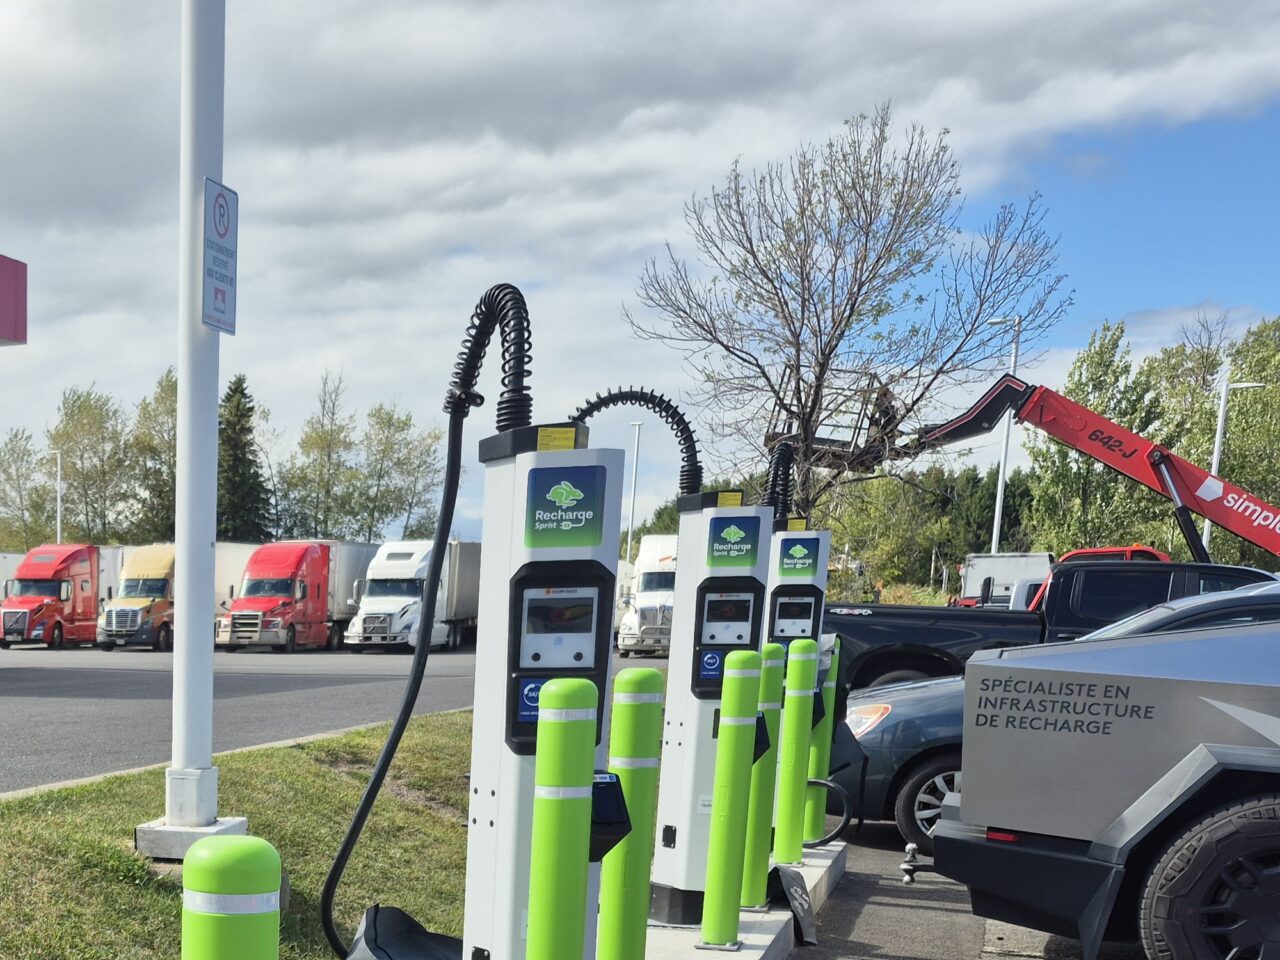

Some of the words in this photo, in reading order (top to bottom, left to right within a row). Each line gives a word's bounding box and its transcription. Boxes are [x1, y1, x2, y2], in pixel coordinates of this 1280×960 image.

[1087, 428, 1139, 459] 642-J
[534, 521, 557, 531] Sprint
[535, 510, 594, 521] Recharge
[713, 543, 752, 551] Recharge
[980, 675, 1098, 698] SPÉCIALISTE
[1103, 685, 1131, 699] EN
[977, 696, 1156, 720] INFRASTRUCTURE
[975, 713, 1000, 728] DE
[1005, 715, 1113, 735] RECHARGE
